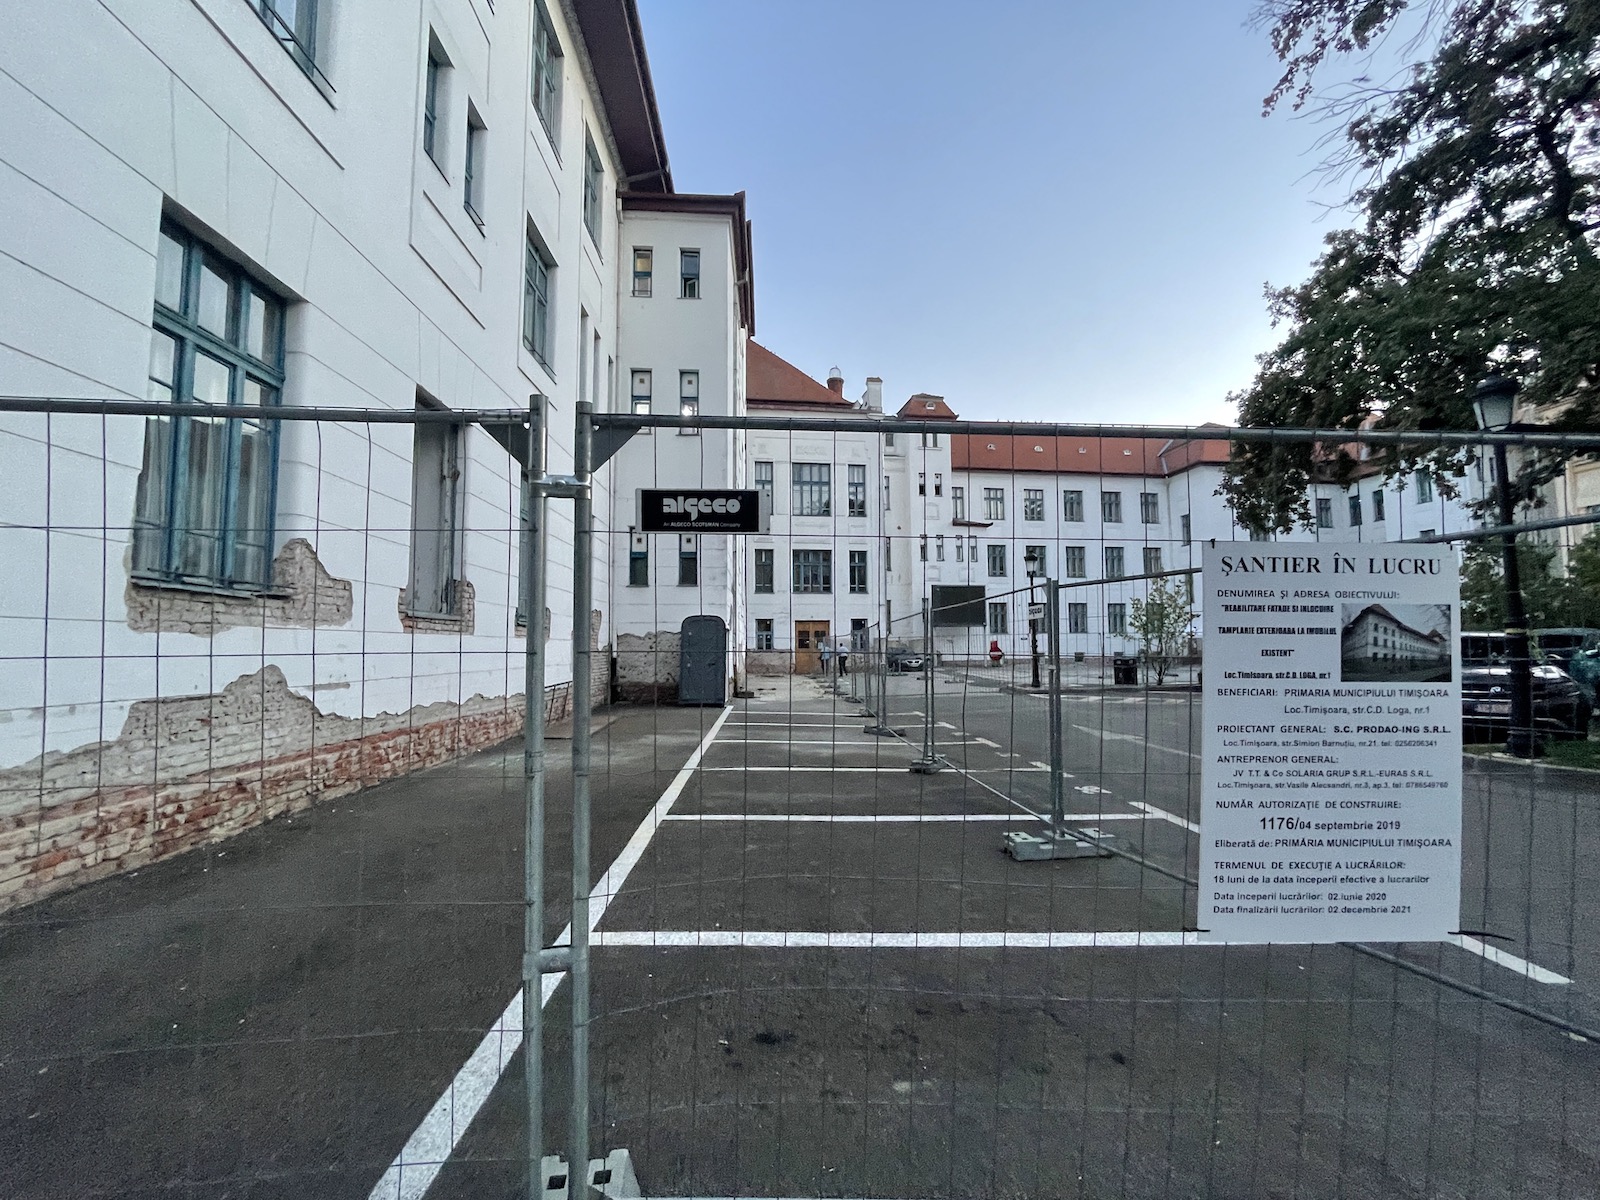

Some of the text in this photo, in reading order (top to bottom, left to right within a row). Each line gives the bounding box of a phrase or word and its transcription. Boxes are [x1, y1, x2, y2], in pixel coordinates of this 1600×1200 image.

[662, 496, 741, 521] algeco
[1333, 552, 1356, 574] ÎN
[1369, 557, 1441, 575] LUCRU
[1217, 589, 1275, 598] DENUMIREA
[1293, 590, 1330, 599] ADRESA
[1335, 590, 1400, 599] OBIECTIVULUI:
[1297, 627, 1305, 635] LA
[1217, 688, 1278, 697] BENEFICIARI:
[1333, 689, 1396, 698] MUNICIPIULUI
[1387, 706, 1412, 716] Loga,
[1414, 706, 1430, 715] nr.1
[1217, 725, 1451, 734] PROIECTANT GENERAL: S.C. PRODAO-ING S.R.L.
[1216, 755, 1339, 764] ANTREPRENOR GENERAL:
[1232, 769, 1244, 777] JV
[1263, 769, 1270, 777] &
[1271, 769, 1284, 777] Co
[1285, 769, 1324, 777] SOLARIA
[1326, 770, 1351, 778] GRUP
[1215, 799, 1254, 809] NUMĂR
[1325, 801, 1337, 809] DE
[1340, 801, 1402, 810] CONSTRUIRE:
[1314, 821, 1374, 831] septembrie
[1376, 821, 1401, 830] 2019
[1258, 840, 1273, 848] de:
[1326, 839, 1395, 847] MUNICIPIULUI
[1214, 861, 1267, 870] TERMENUL
[1271, 861, 1284, 870] DE
[1334, 861, 1342, 870] A
[1345, 860, 1406, 870] LUCRĂRILOR:
[1214, 875, 1225, 883] 18
[1227, 875, 1245, 883] luni
[1247, 875, 1260, 883] de
[1262, 875, 1271, 883] la
[1273, 875, 1294, 884] data
[1340, 875, 1377, 884] efective
[1213, 892, 1235, 900] Data
[1213, 905, 1235, 914] Data
[1390, 905, 1411, 913] 2021
